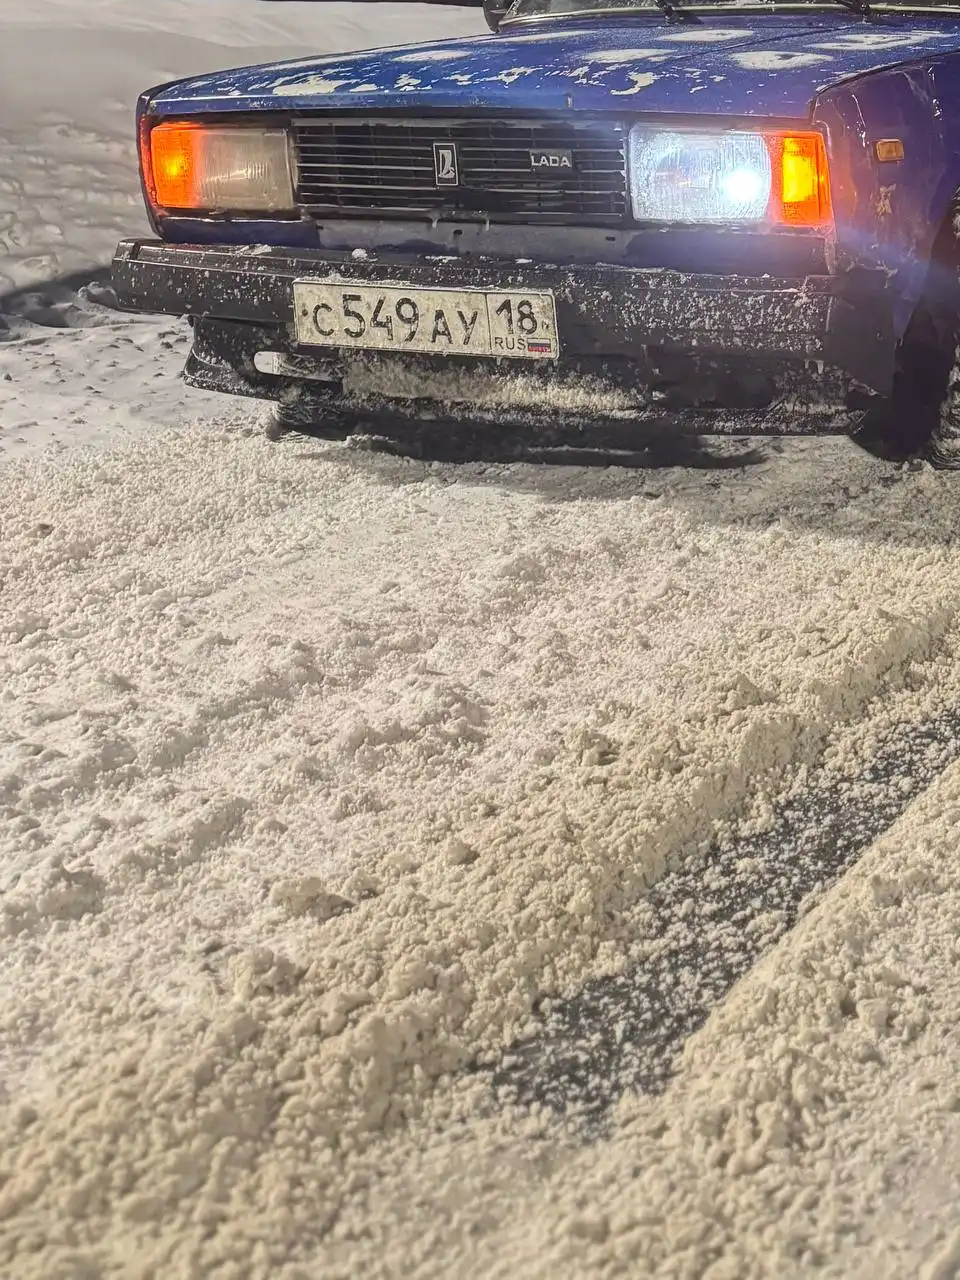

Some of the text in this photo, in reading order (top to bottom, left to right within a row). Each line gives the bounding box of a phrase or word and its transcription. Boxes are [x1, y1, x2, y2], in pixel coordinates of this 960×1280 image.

[530, 155, 572, 168] LADA
[495, 298, 539, 336] 18
[494, 336, 527, 351] RUS
